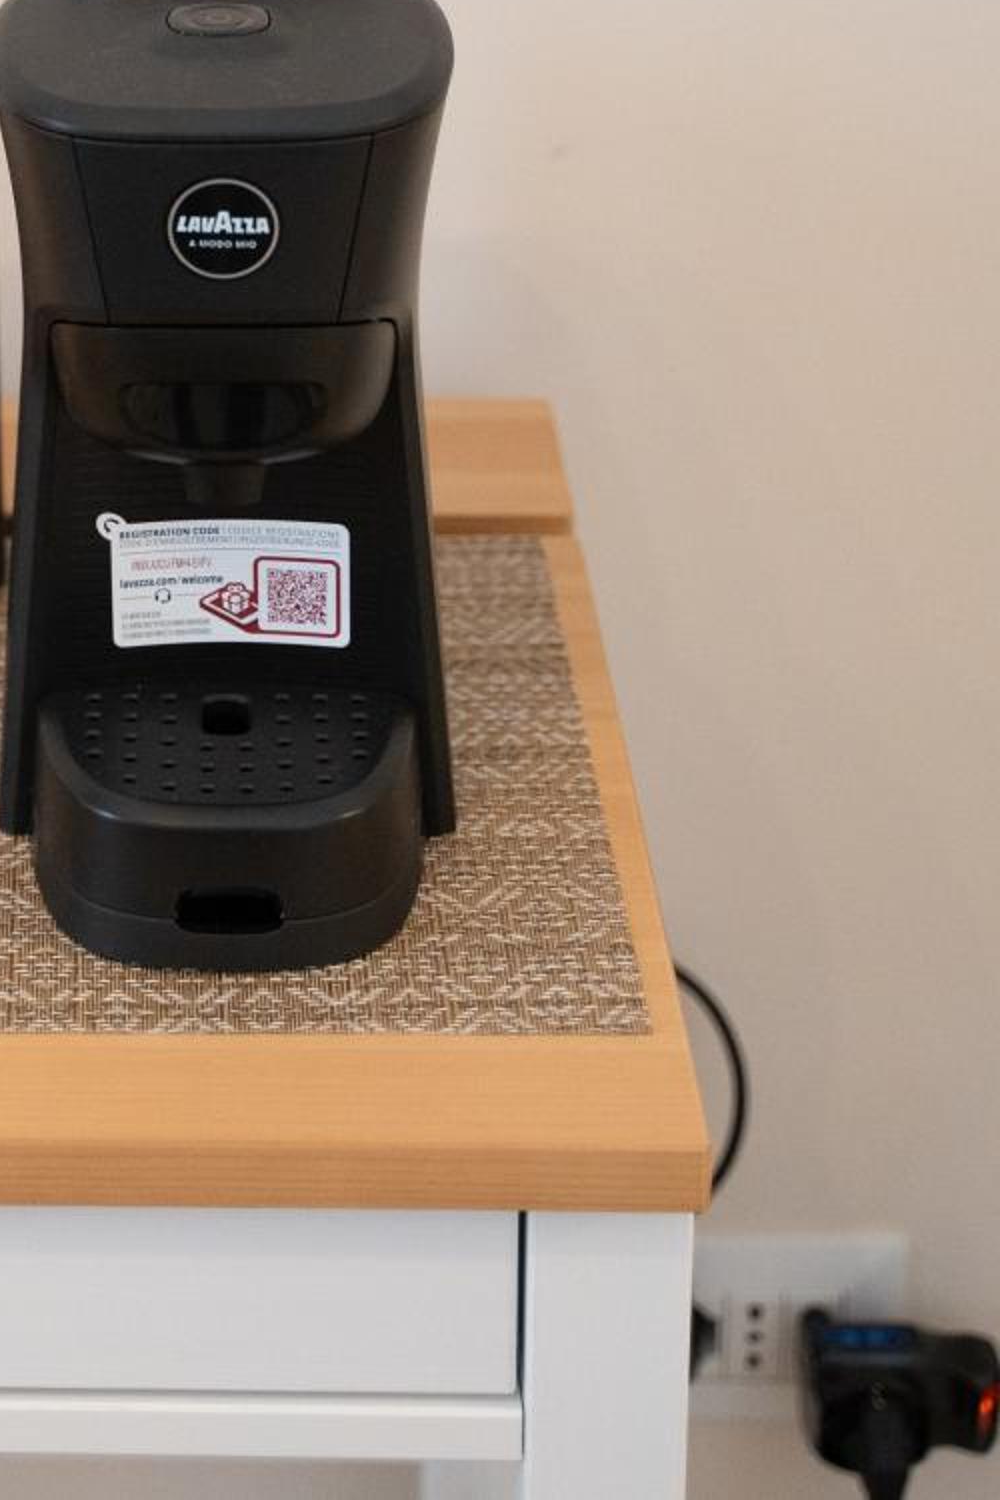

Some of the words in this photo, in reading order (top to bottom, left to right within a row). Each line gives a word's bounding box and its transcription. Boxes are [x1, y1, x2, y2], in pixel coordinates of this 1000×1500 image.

[176, 210, 270, 235] LAVAZZA
[199, 239, 232, 249] MODO
[235, 240, 257, 250] MIO
[119, 527, 190, 539] REGISTRATION
[191, 526, 220, 535] CODE
